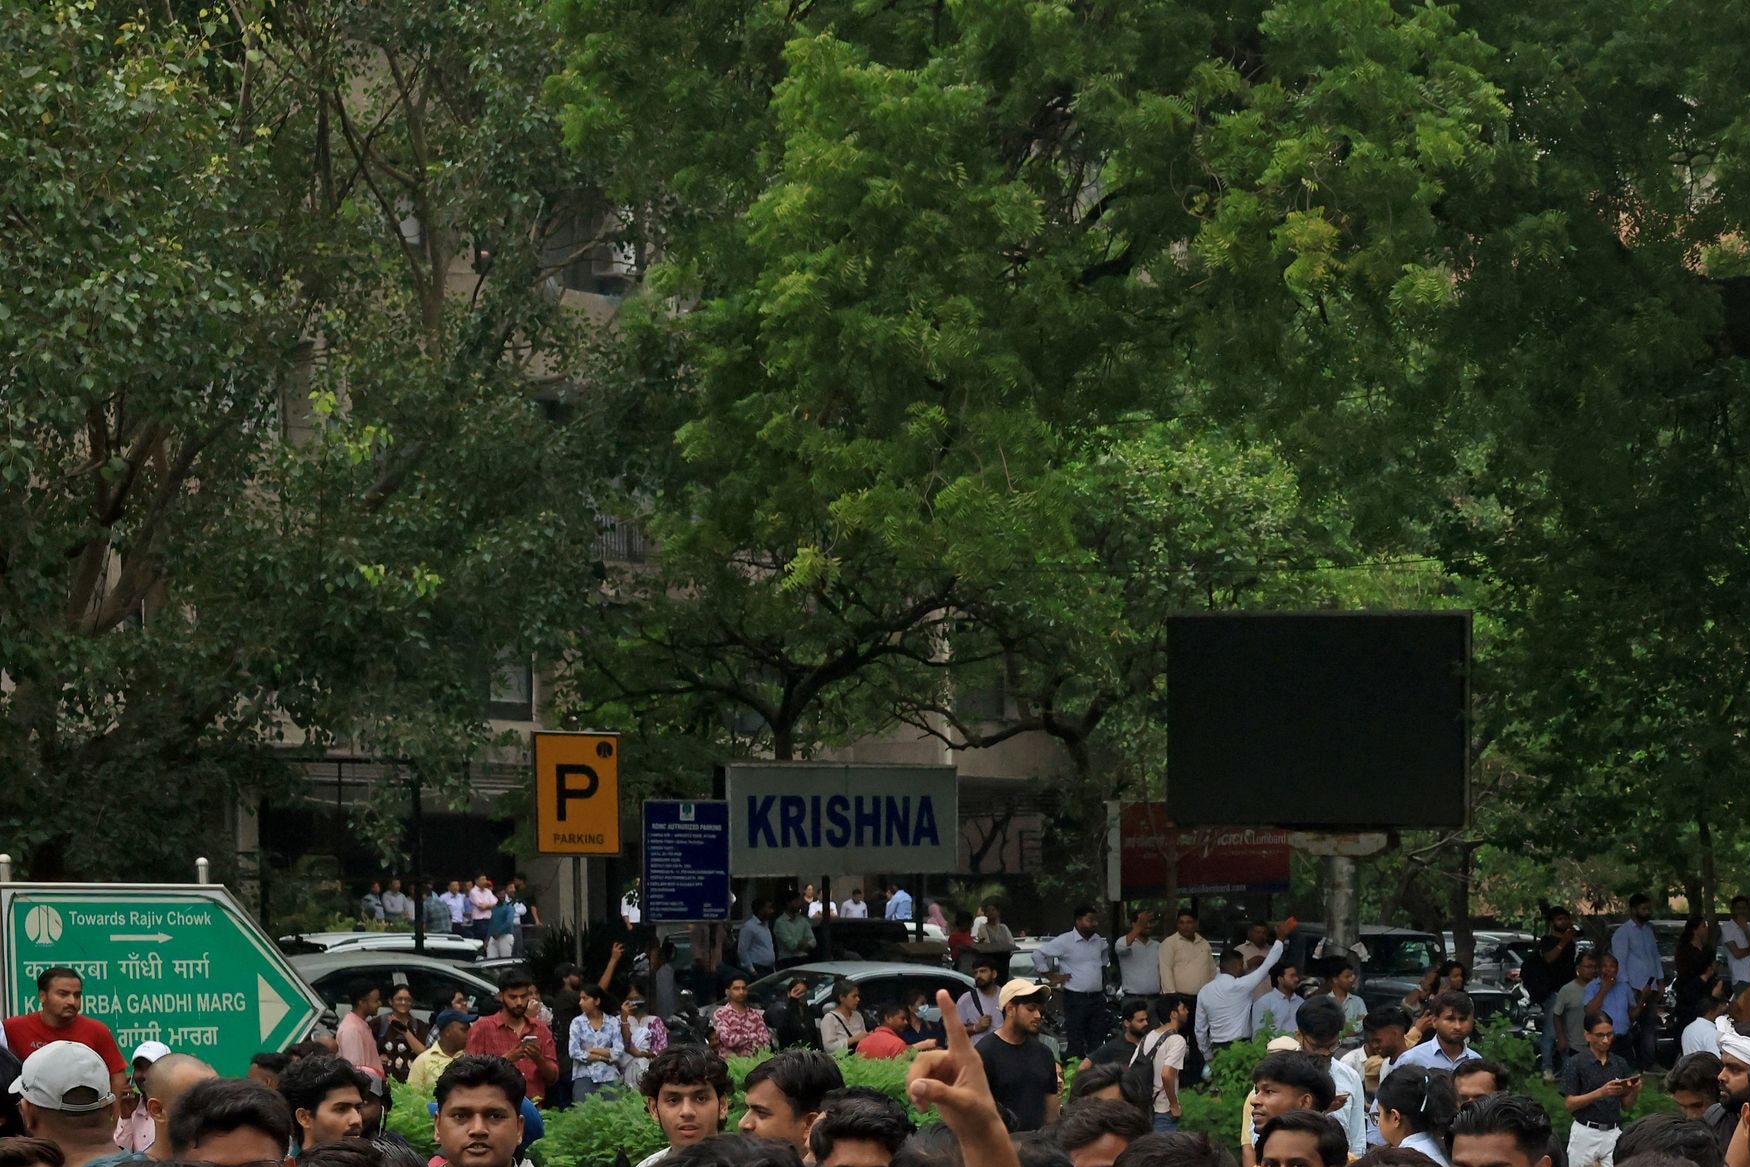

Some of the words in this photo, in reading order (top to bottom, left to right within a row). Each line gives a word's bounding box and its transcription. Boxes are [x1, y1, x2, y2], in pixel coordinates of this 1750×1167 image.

[556, 764, 599, 821] P
[748, 794, 940, 849] KRISHNA
[553, 832, 605, 845] PARKING
[69, 911, 126, 926] Towards
[130, 911, 162, 929] Rajiv
[167, 911, 212, 926] Chowk
[172, 951, 210, 979] मार्ग
[24, 994, 122, 1015] KRBA
[126, 993, 192, 1014] GANDHI
[197, 992, 246, 1012] MARG
